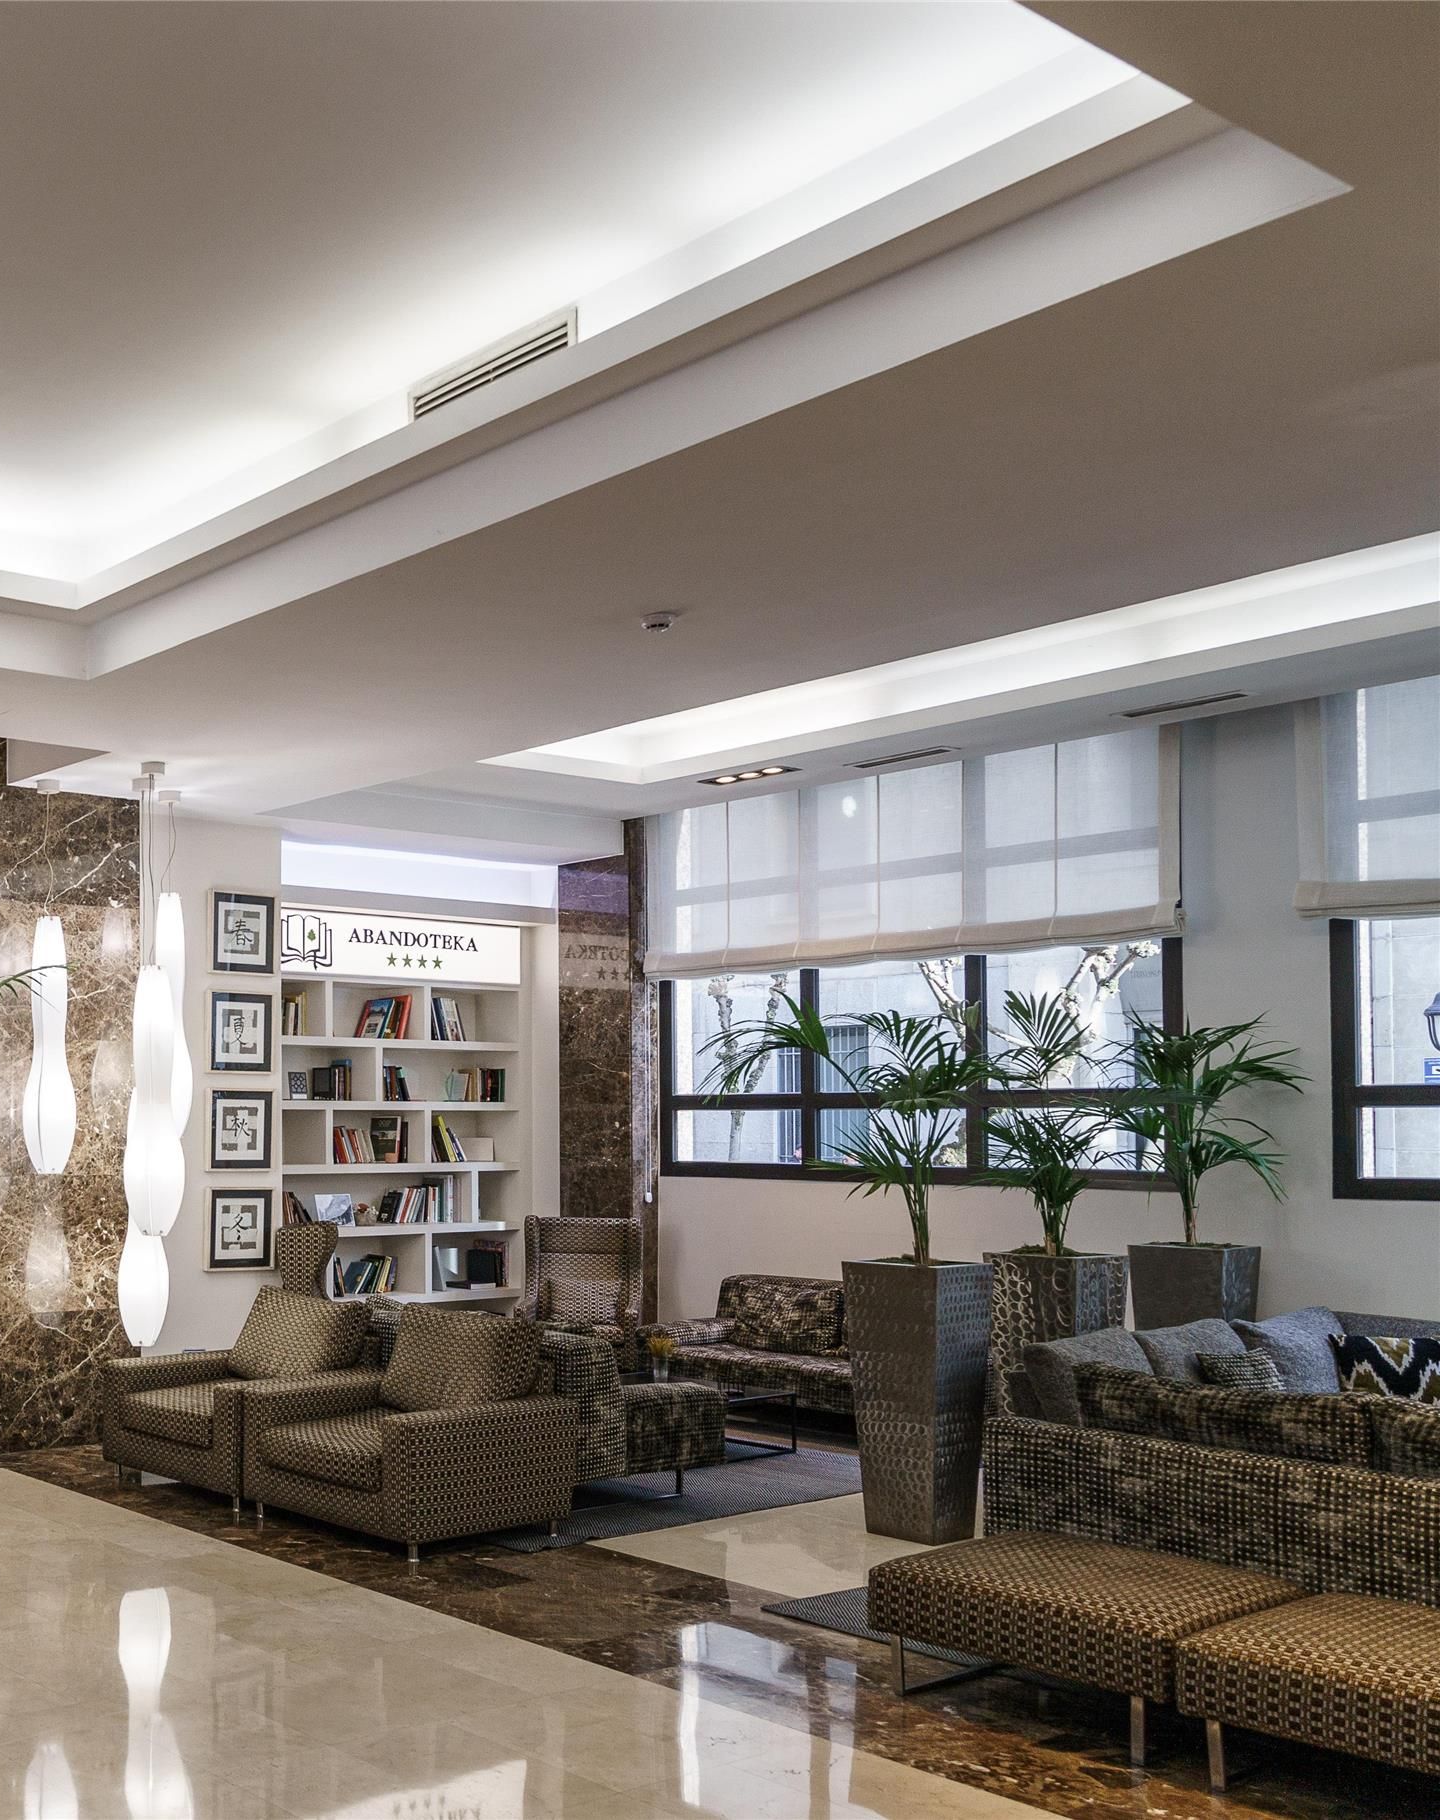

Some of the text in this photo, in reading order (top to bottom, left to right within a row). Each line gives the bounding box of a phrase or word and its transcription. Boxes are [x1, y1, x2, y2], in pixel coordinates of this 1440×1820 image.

[231, 918, 253, 946] 春
[348, 927, 479, 953] ABANDOTEKA
[231, 1016, 246, 1045] 夏
[231, 1115, 250, 1141] 秋
[230, 1213, 249, 1241] 冬
